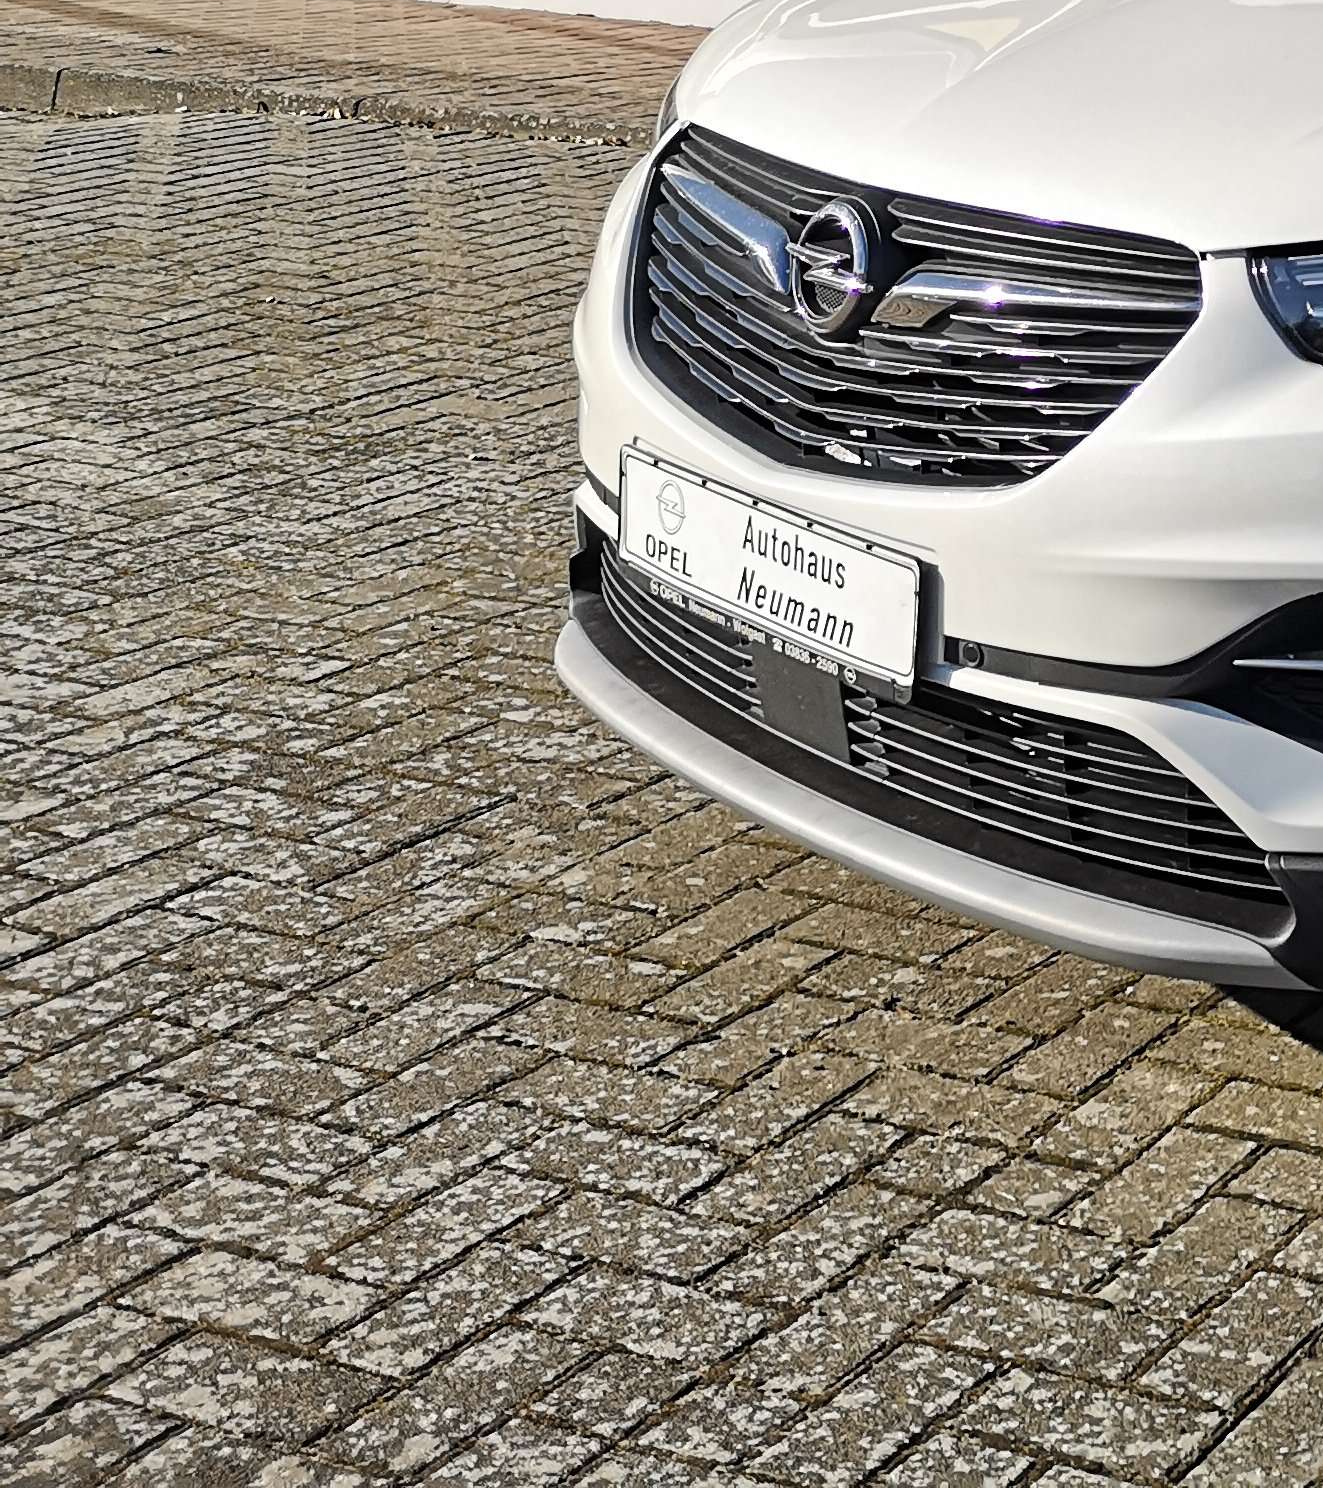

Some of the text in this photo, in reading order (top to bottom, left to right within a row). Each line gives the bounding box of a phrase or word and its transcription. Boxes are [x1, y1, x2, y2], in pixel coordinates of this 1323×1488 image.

[645, 533, 692, 578] OPEL
[743, 515, 846, 589] Autohaus
[660, 587, 685, 608] OPEL
[737, 566, 855, 649] Neumann
